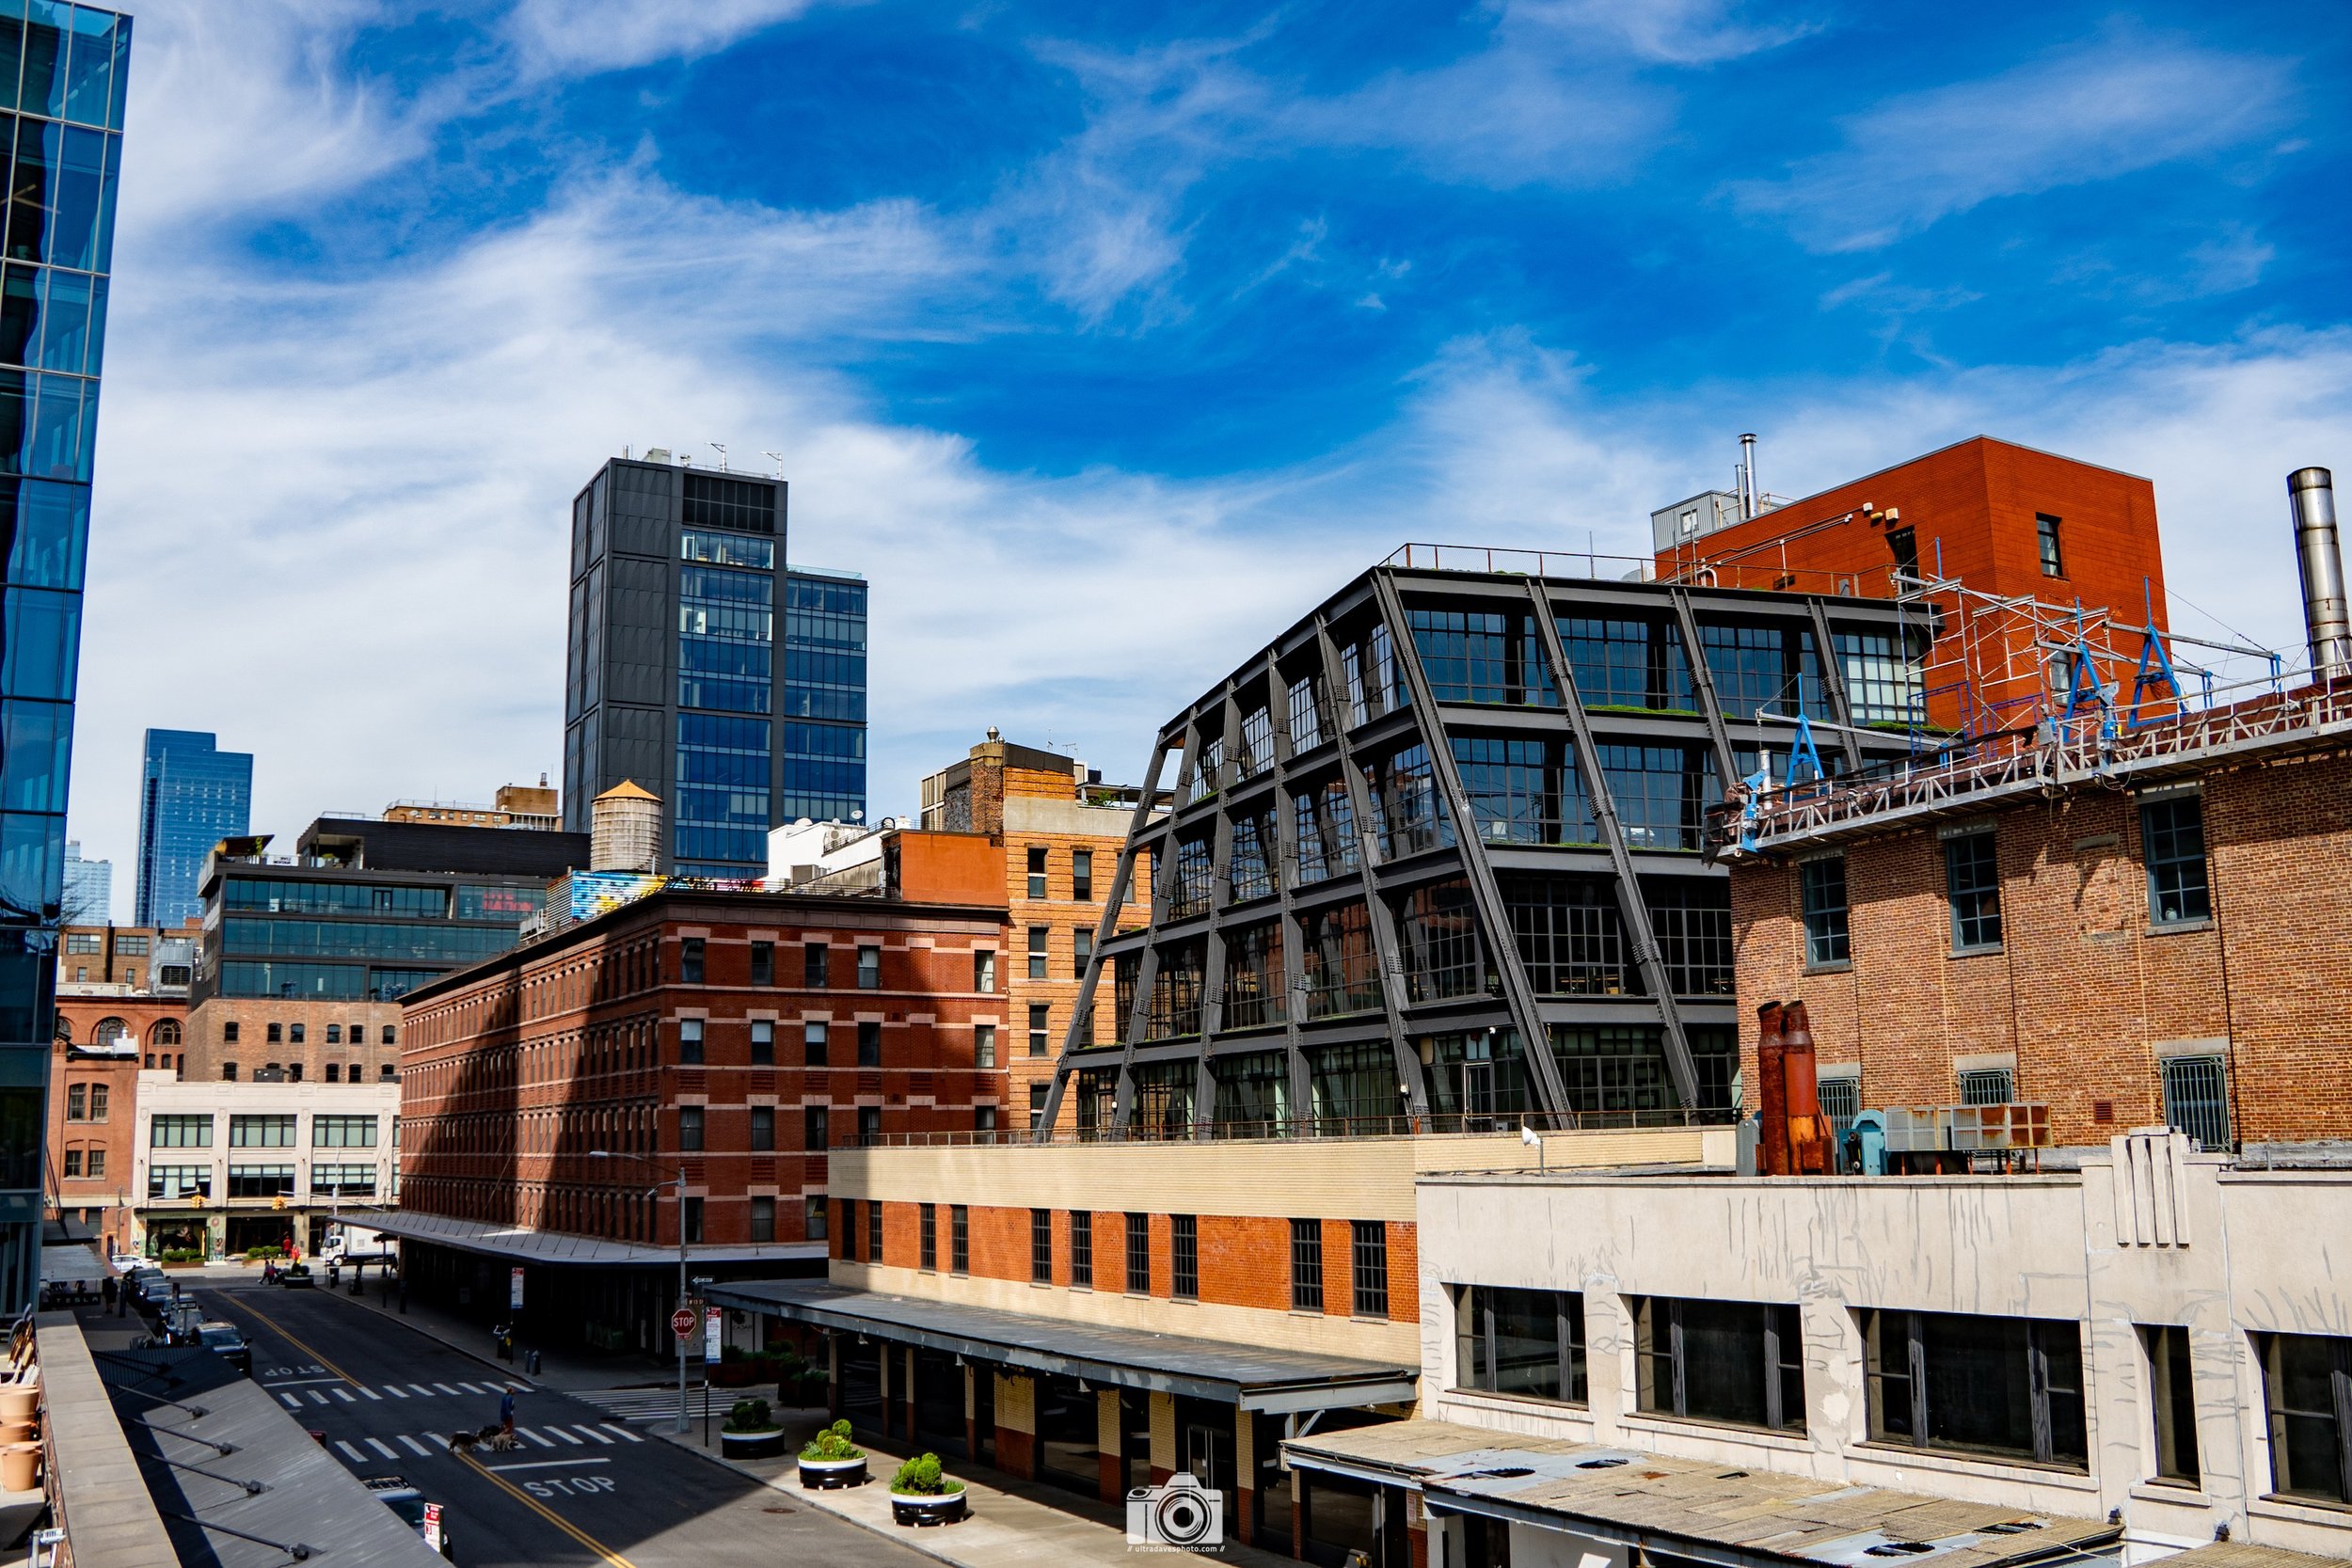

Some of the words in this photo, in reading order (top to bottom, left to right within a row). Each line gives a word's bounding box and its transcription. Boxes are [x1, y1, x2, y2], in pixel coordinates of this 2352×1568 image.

[673, 1316, 694, 1327] STOP
[264, 1365, 326, 1376] STOP
[523, 1476, 616, 1497] STOP
